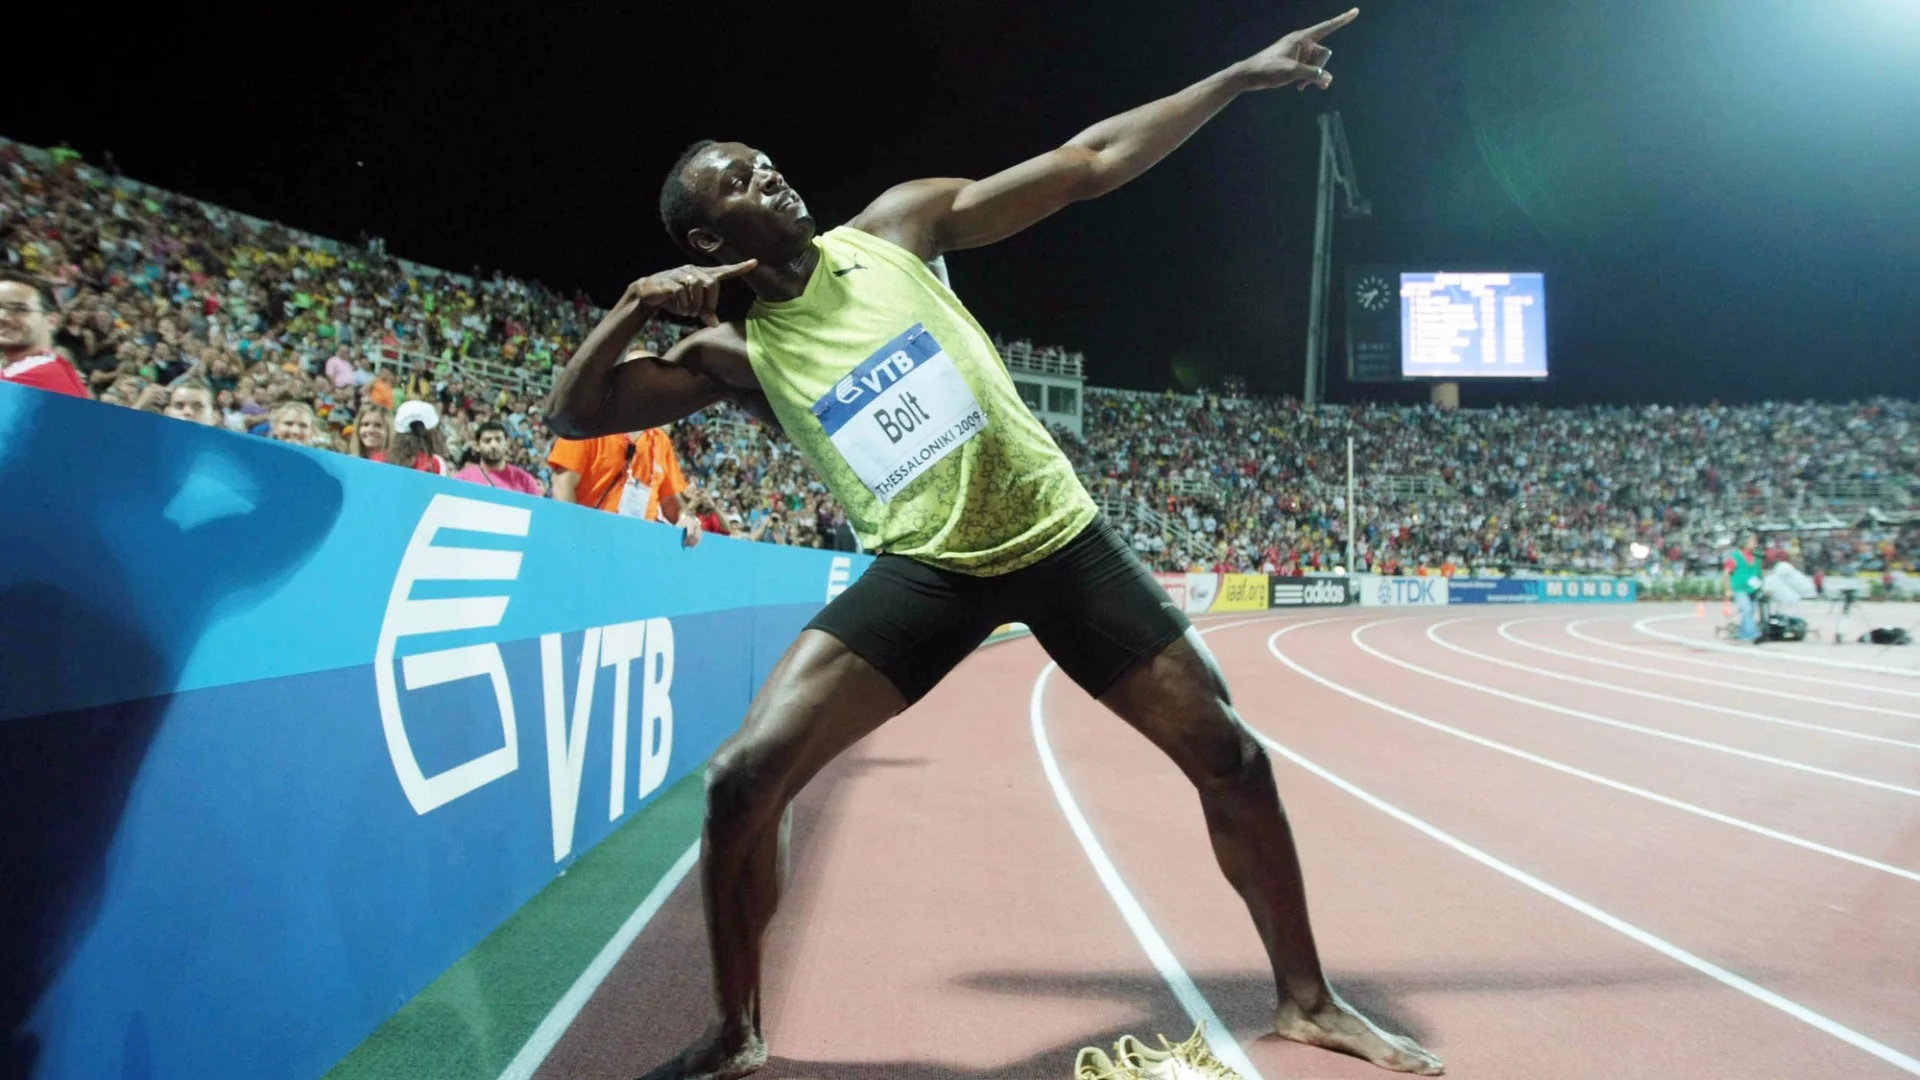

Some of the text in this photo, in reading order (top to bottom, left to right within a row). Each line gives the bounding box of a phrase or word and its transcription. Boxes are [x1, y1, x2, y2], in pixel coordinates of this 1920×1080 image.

[860, 350, 914, 394] VTB
[873, 391, 930, 444] Bolt
[874, 410, 982, 495] THESSALONIKI 2009
[1304, 580, 1345, 602] adidas
[1392, 579, 1436, 605] TDK
[1546, 581, 1630, 598] MONDO
[540, 617, 675, 863] VTB
